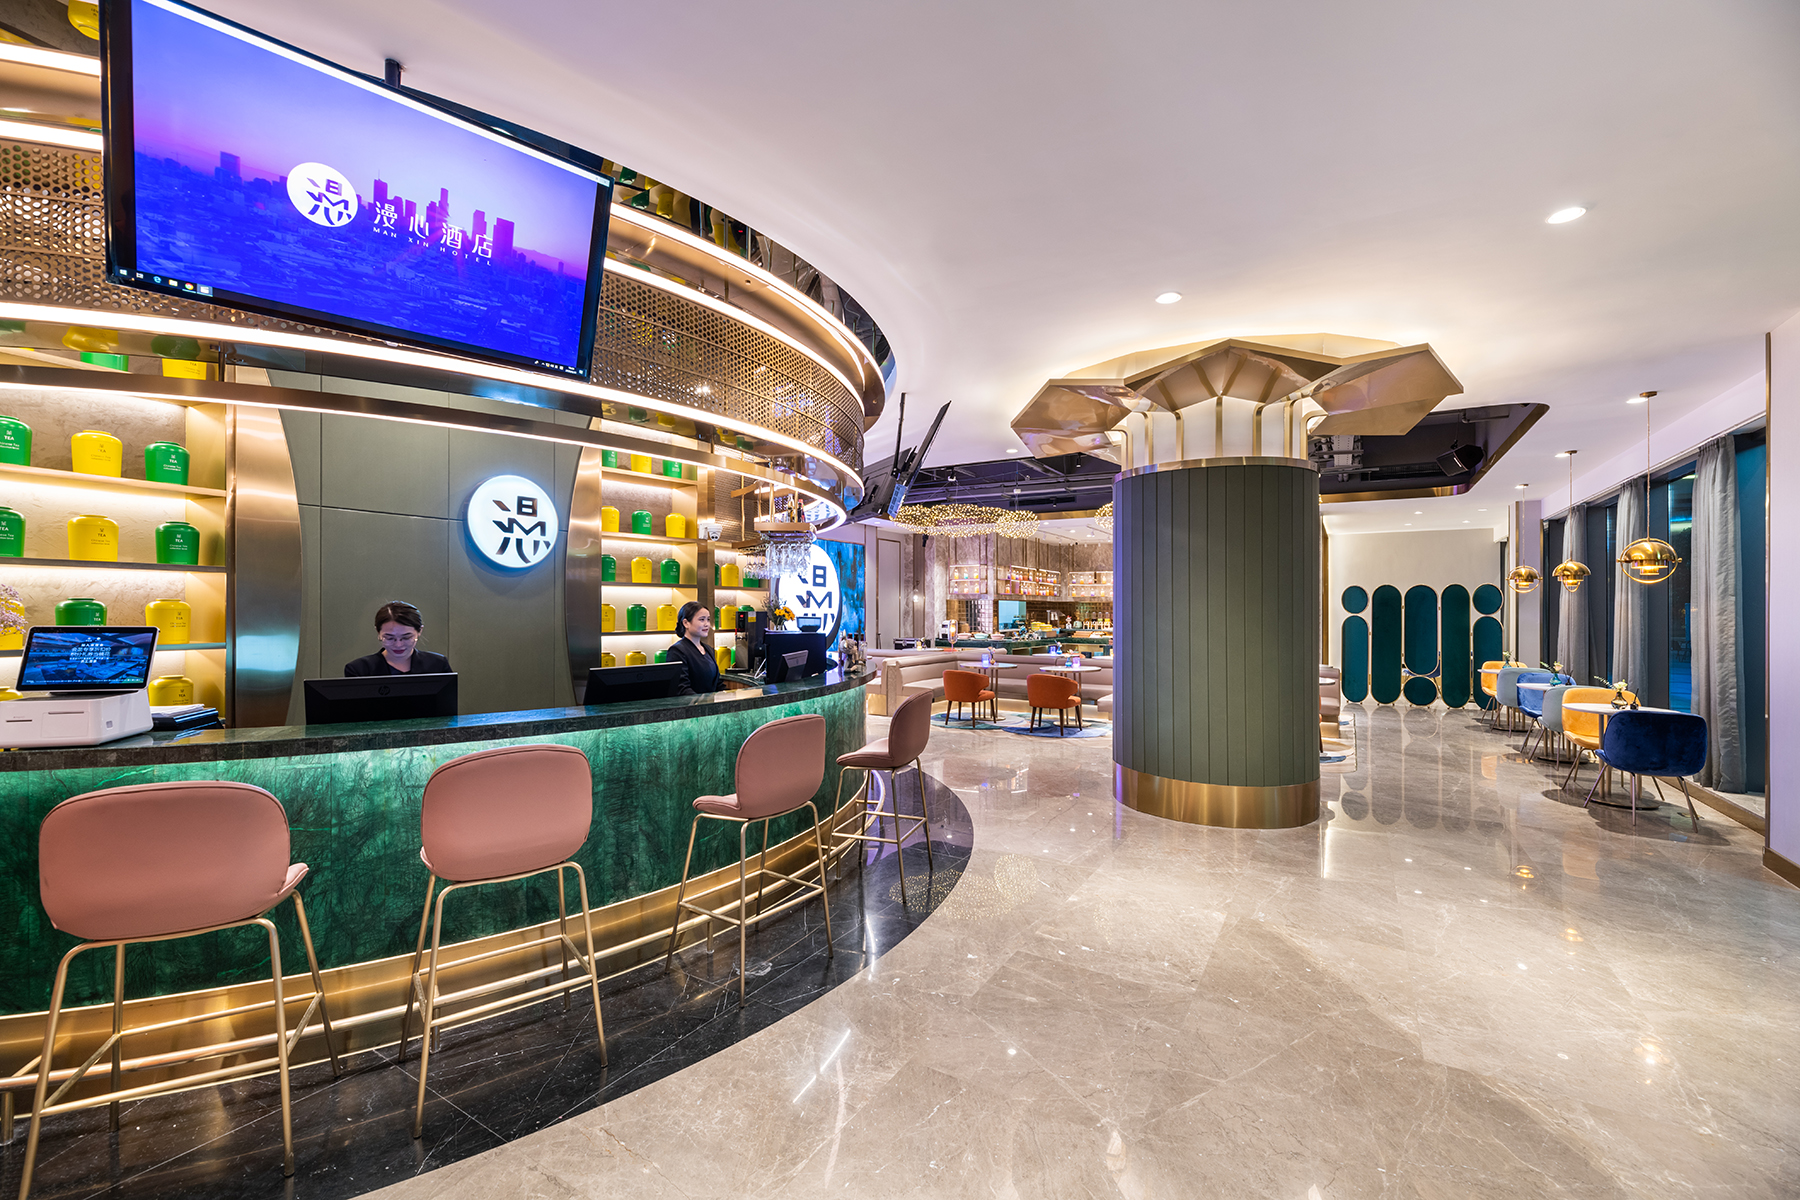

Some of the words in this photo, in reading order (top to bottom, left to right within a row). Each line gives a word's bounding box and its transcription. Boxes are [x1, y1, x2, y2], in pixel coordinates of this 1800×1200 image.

[373, 226, 397, 239] MAN
[408, 237, 429, 248] XIN
[440, 246, 492, 266] HOTEL
[374, 201, 493, 259] 漫心酒店
